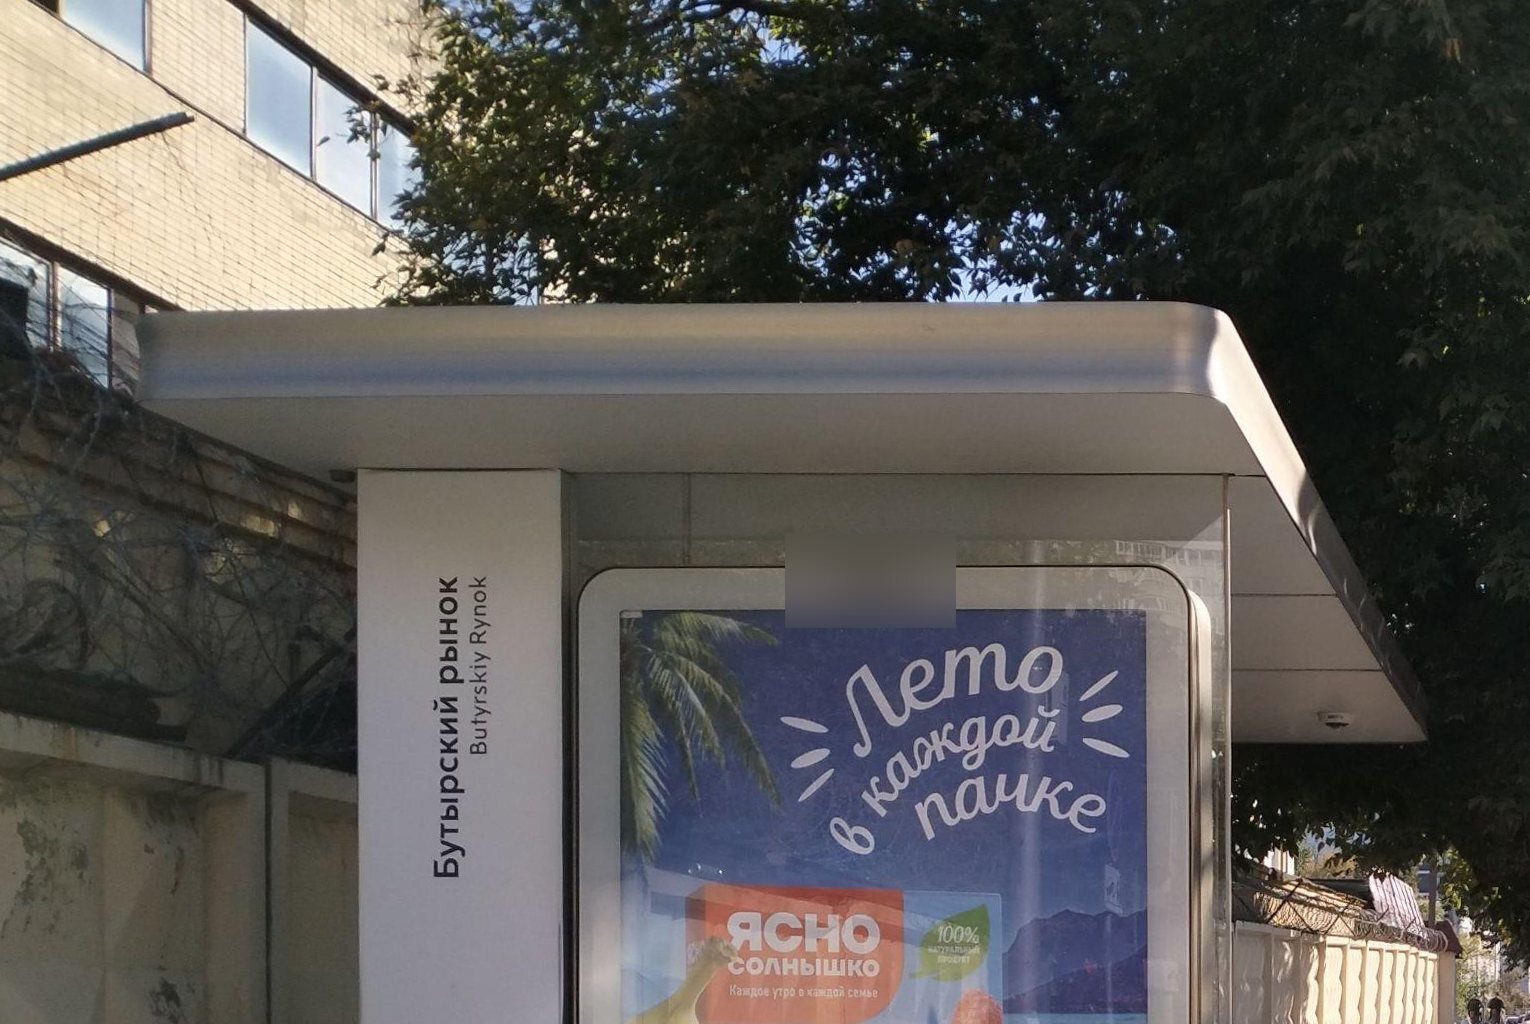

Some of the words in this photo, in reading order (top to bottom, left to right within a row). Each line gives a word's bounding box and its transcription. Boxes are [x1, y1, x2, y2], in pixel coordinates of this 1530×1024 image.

[439, 577, 464, 684] рынок
[468, 576, 491, 644] Rynok
[469, 652, 491, 755] Butyrskiy
[846, 643, 1063, 758] Лето
[433, 697, 465, 877] Бутырский
[829, 816, 875, 855] в
[861, 705, 1060, 817] каждой
[914, 773, 1107, 841] пачке
[727, 911, 880, 954] ЯСНО
[937, 925, 979, 944] 100%
[729, 984, 770, 998] Каждое
[773, 985, 796, 999] утро
[807, 985, 845, 998] каждой
[847, 987, 879, 998] семье
